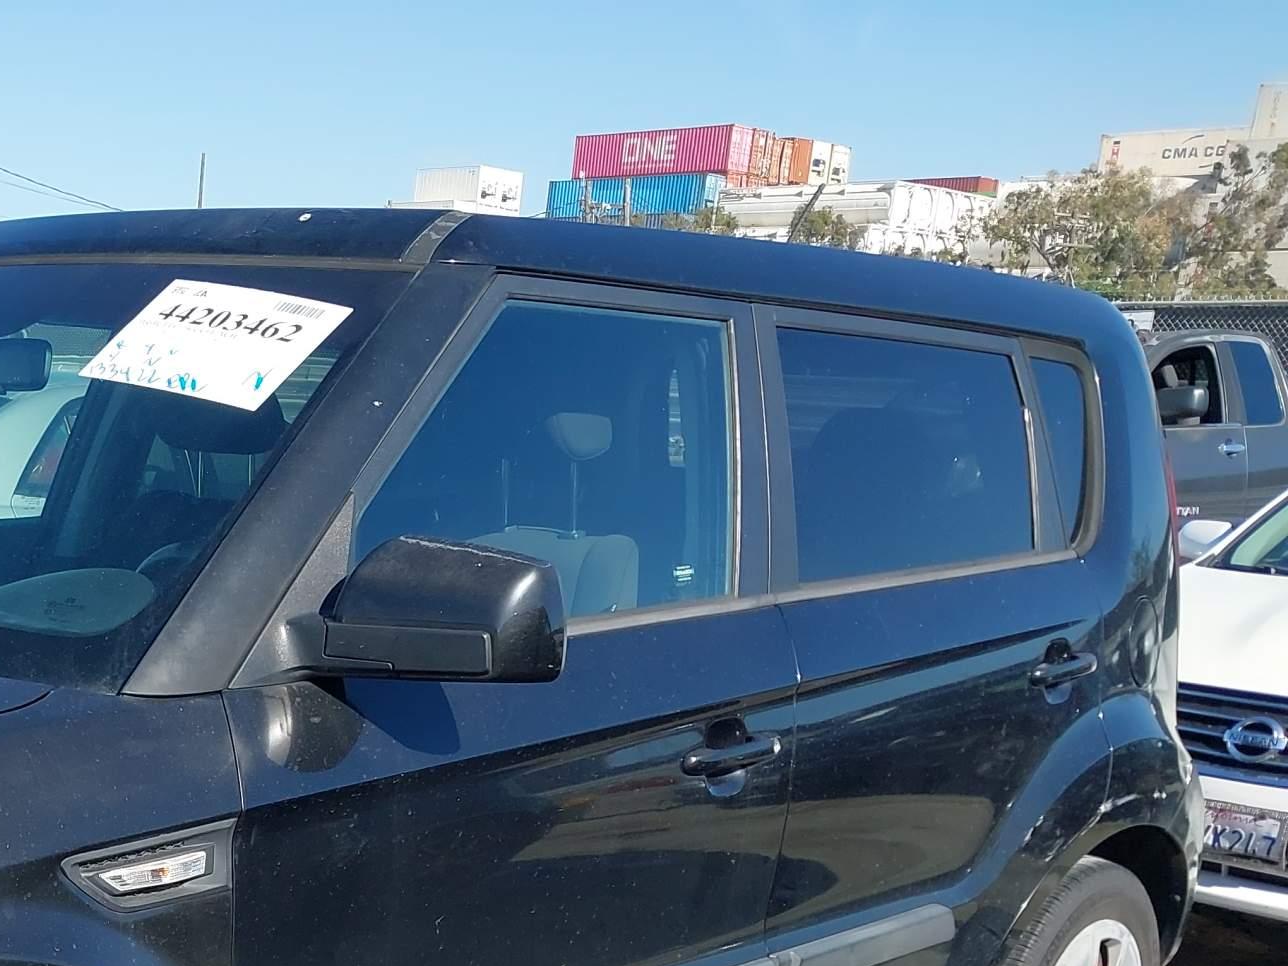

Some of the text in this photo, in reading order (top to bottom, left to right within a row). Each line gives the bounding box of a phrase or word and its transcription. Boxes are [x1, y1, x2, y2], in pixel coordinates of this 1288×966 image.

[622, 135, 677, 162] ONE
[1161, 145, 1226, 160] CMA CG
[159, 303, 304, 344] 44203462
